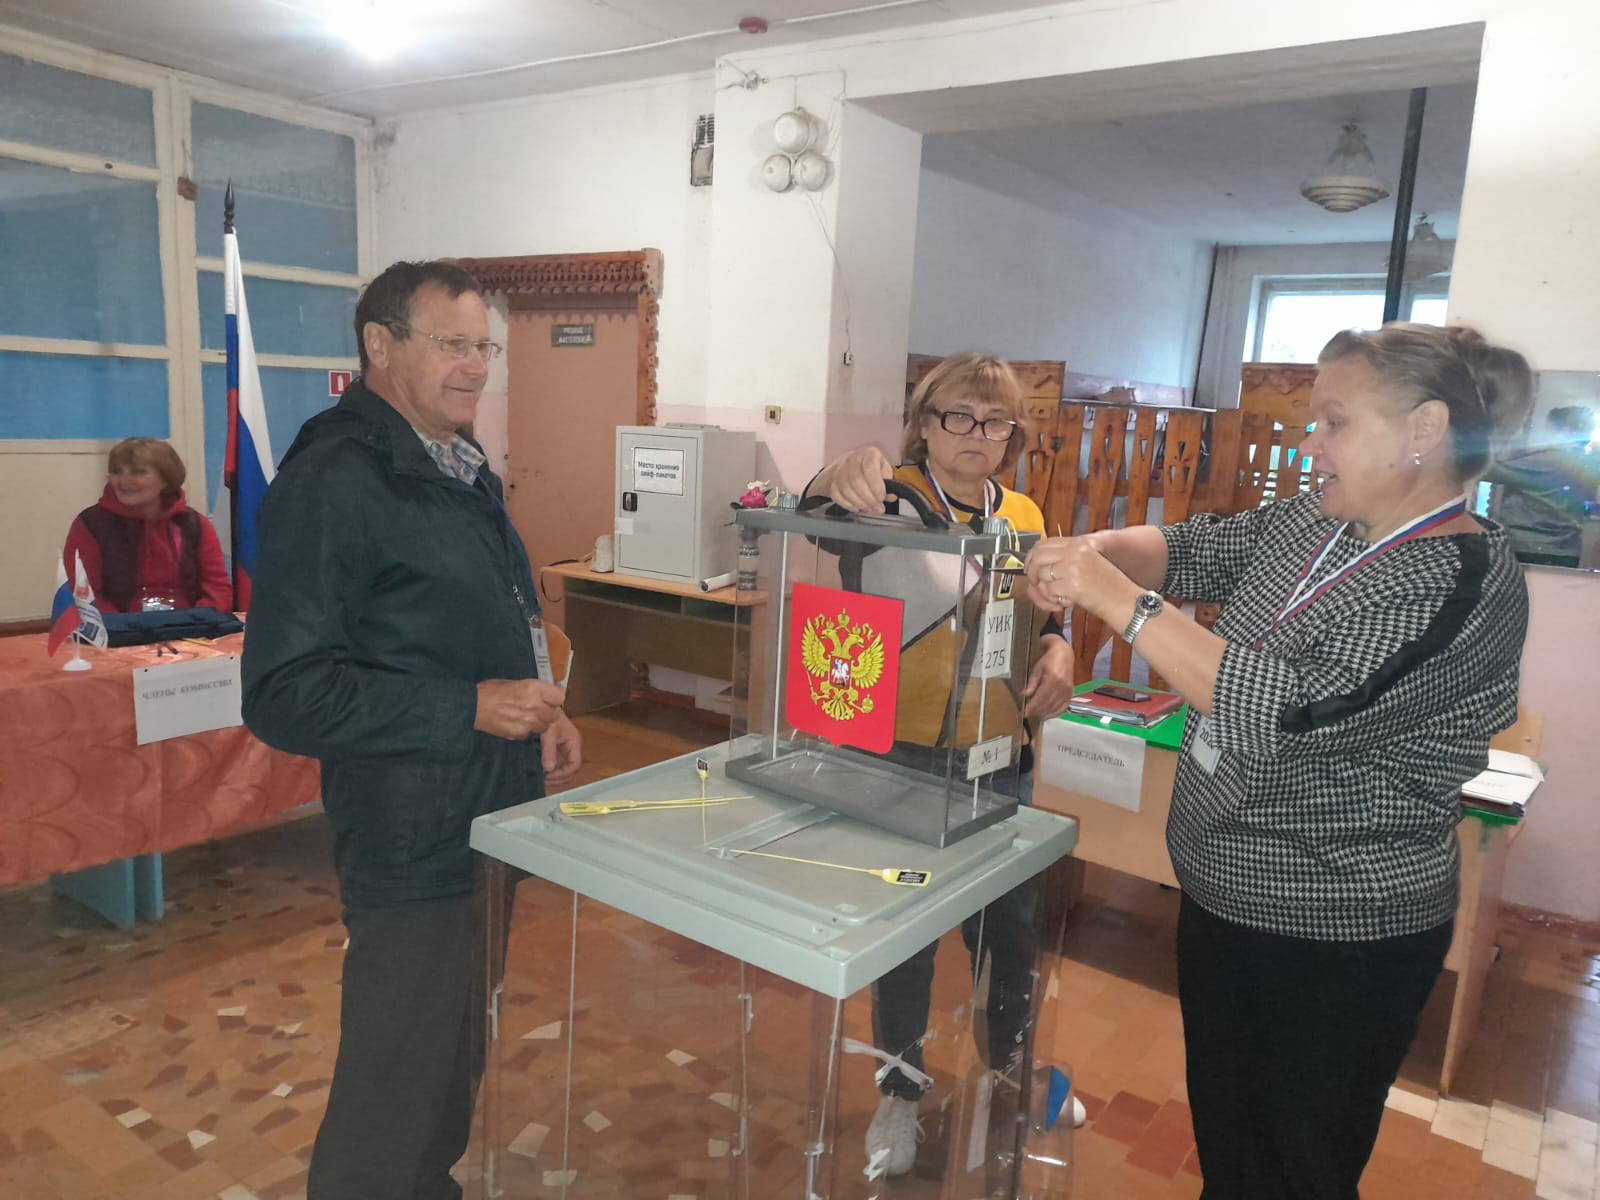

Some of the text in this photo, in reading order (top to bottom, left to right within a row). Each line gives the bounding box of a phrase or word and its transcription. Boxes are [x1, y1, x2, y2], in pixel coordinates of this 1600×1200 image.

[987, 614, 1012, 635] УИК
[985, 649, 1005, 669] 275
[1057, 744, 1125, 767] ПРЕДСЕДАТЕЛЬ
